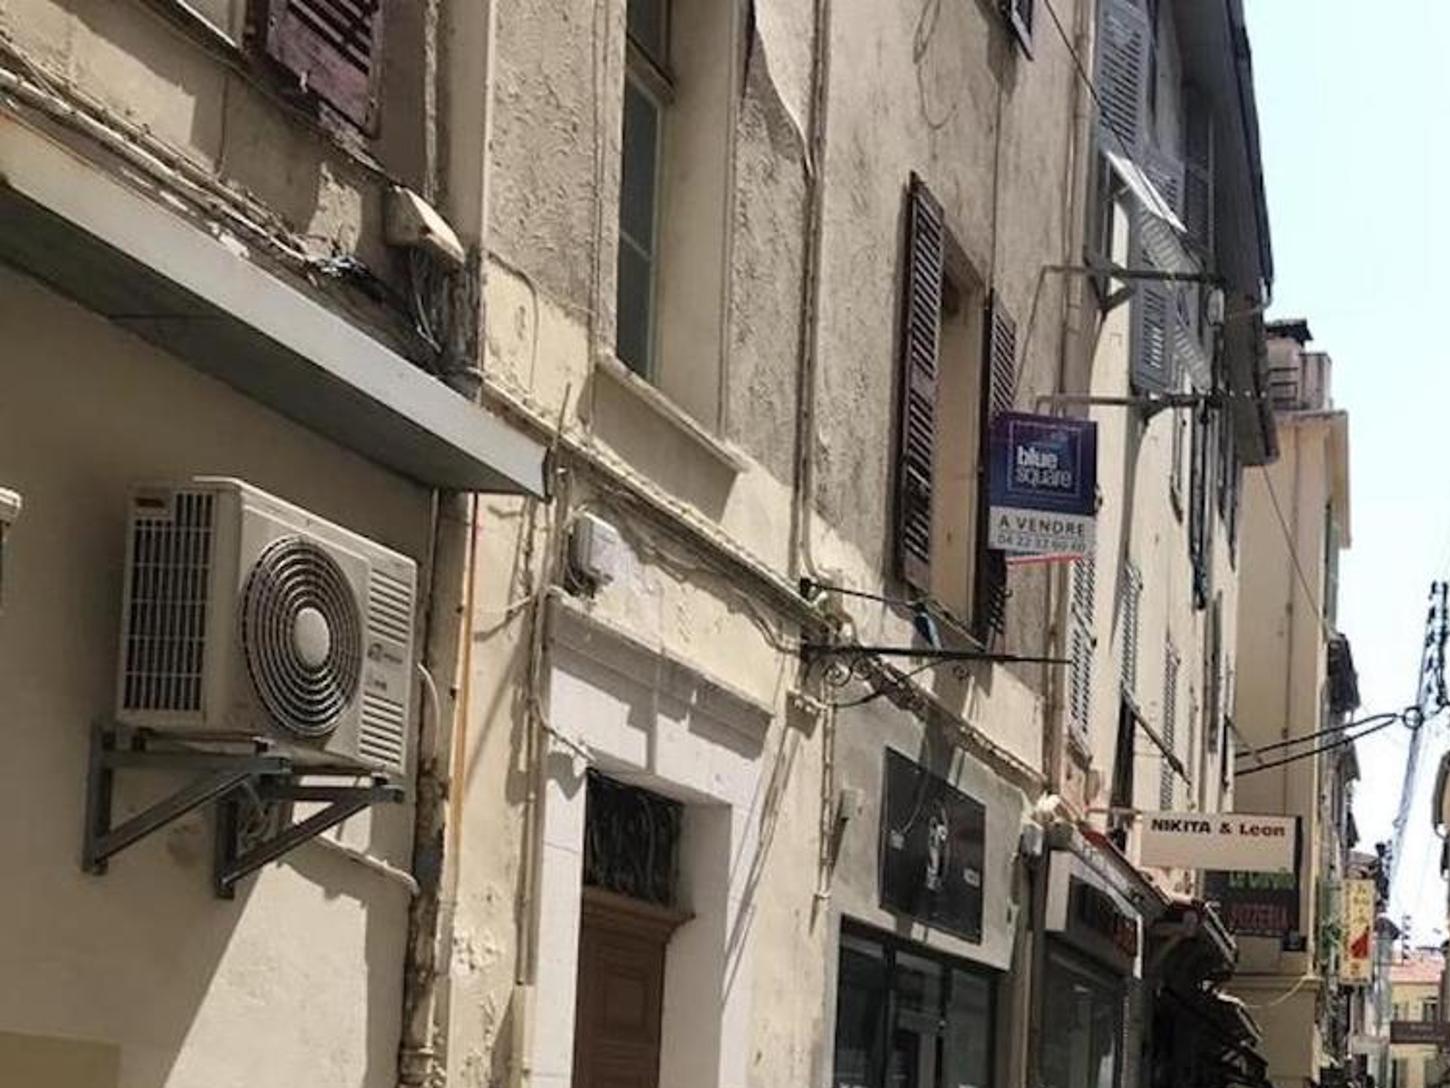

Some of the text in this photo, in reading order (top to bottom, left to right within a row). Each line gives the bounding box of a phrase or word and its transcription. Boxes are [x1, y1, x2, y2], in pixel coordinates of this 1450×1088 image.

[1017, 446, 1058, 470] blue
[1015, 467, 1072, 488] square
[1000, 515, 1085, 536] A VENDRE
[1151, 819, 1285, 837] NIKITA & Leon
